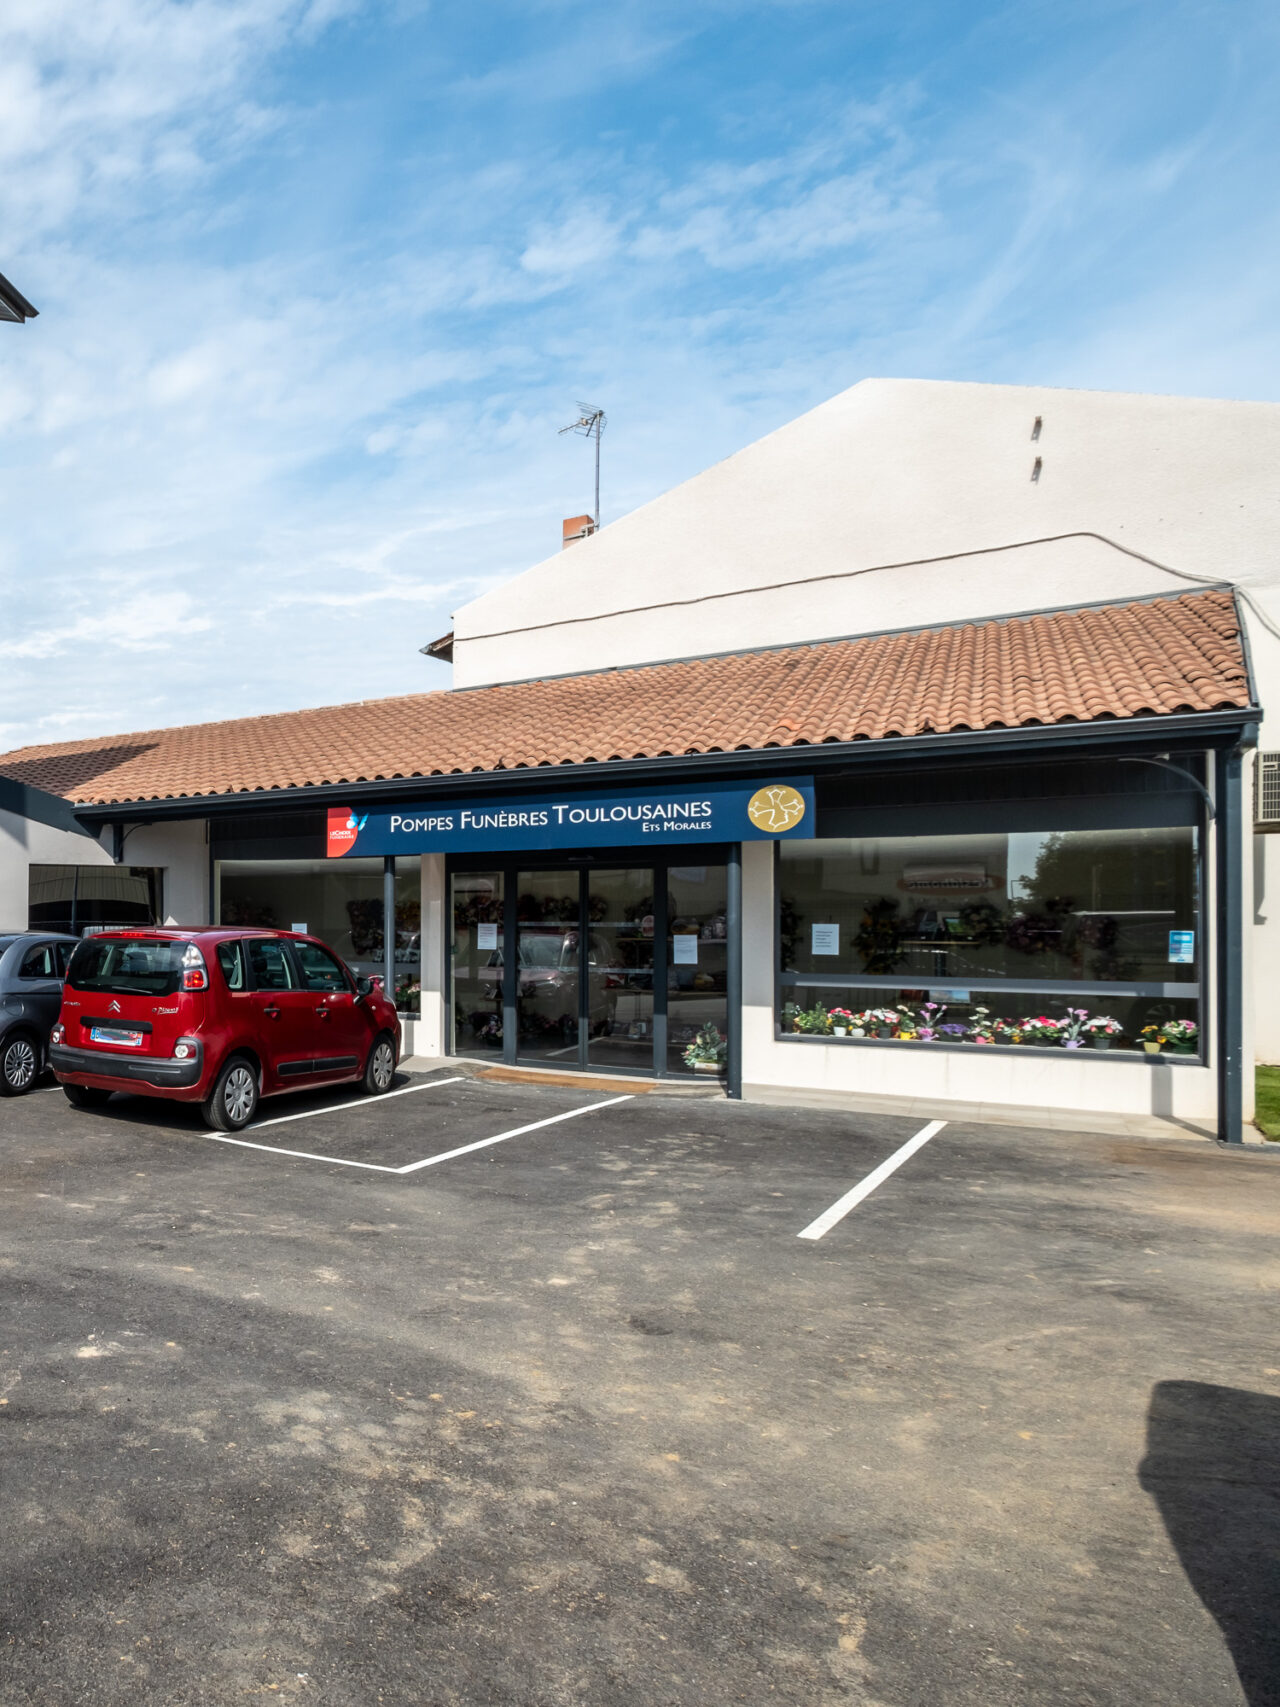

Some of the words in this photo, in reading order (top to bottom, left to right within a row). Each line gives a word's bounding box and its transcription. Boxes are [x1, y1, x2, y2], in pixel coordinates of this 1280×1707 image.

[390, 815, 453, 833] POMPES
[460, 811, 548, 829] FUNÈBRES
[552, 801, 712, 824] TOULOUSAINES
[663, 821, 712, 832] MORALES
